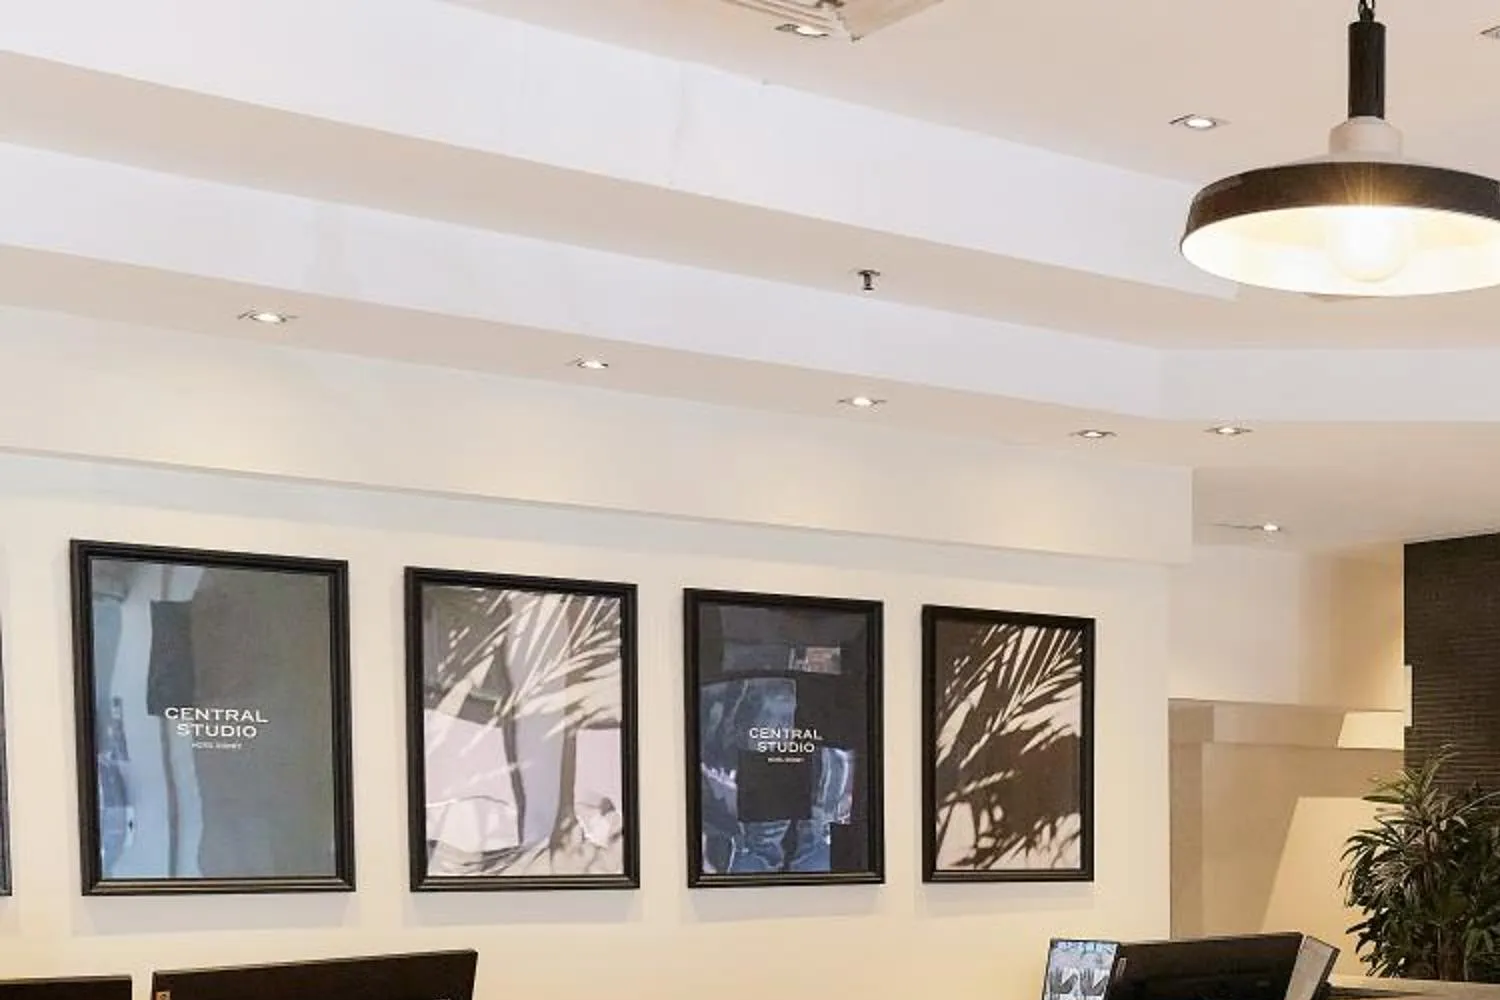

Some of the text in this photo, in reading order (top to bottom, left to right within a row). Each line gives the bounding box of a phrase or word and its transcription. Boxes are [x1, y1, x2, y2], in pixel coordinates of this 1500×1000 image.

[164, 707, 269, 723] CENTRAL
[176, 723, 257, 738] STUDIO
[749, 727, 823, 741] CENTRAL
[757, 741, 815, 753] STUDIO
